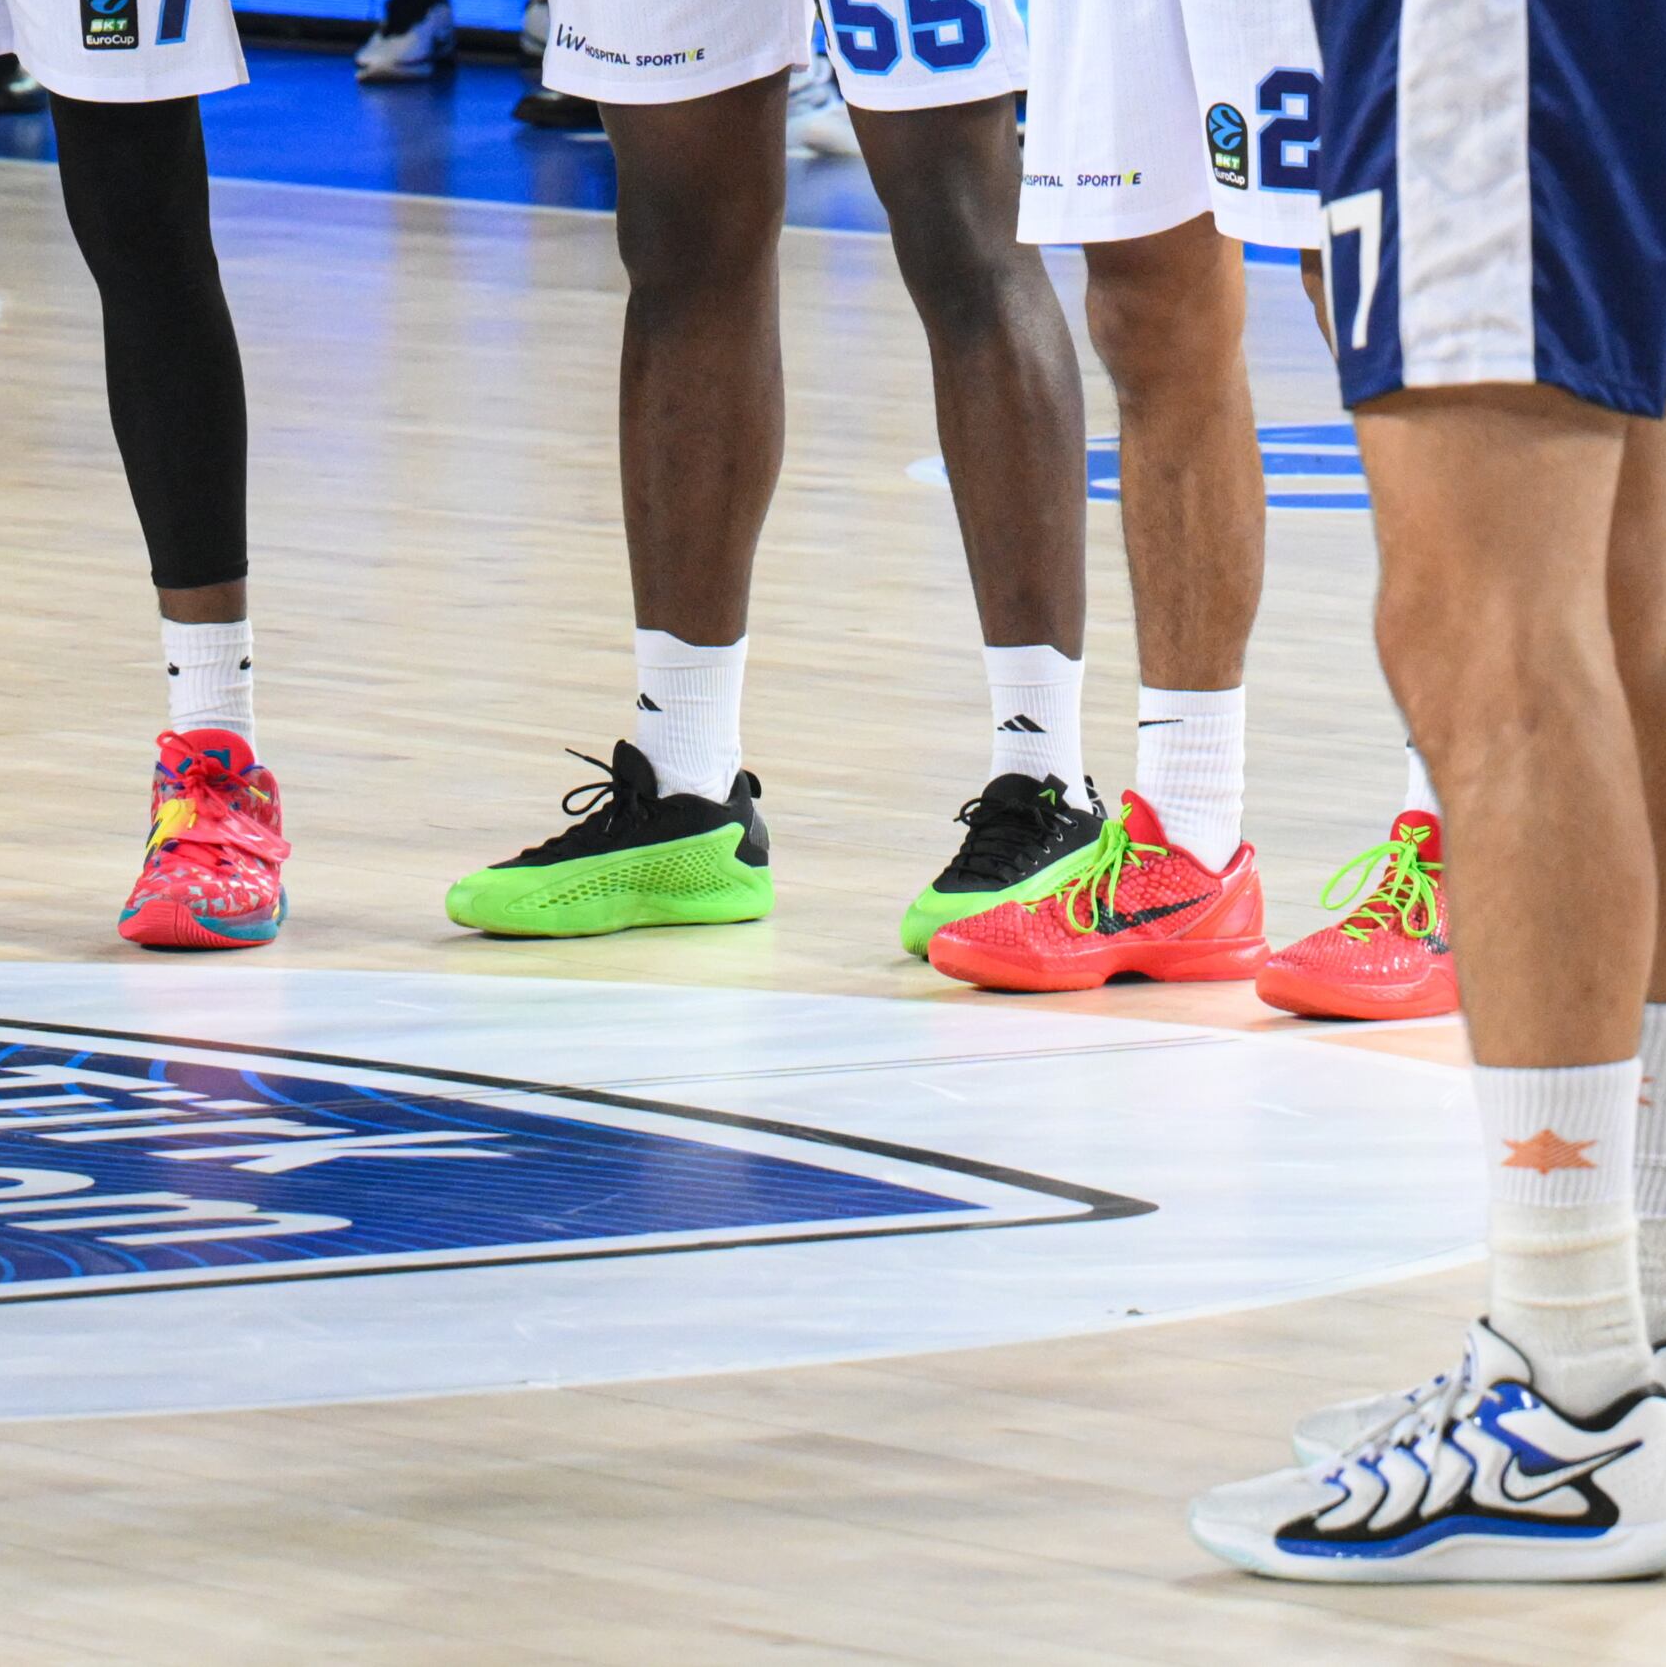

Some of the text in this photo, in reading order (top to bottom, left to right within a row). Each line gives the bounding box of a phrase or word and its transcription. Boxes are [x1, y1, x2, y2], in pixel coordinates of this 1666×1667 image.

[89, 17, 129, 32] BKT
[85, 33, 136, 47] EuroCup
[584, 42, 631, 66] HOSPITAL
[635, 47, 706, 67] SPORTIVE
[1076, 169, 1142, 187] SPORTIVE
[1213, 168, 1247, 186] EuroCup
